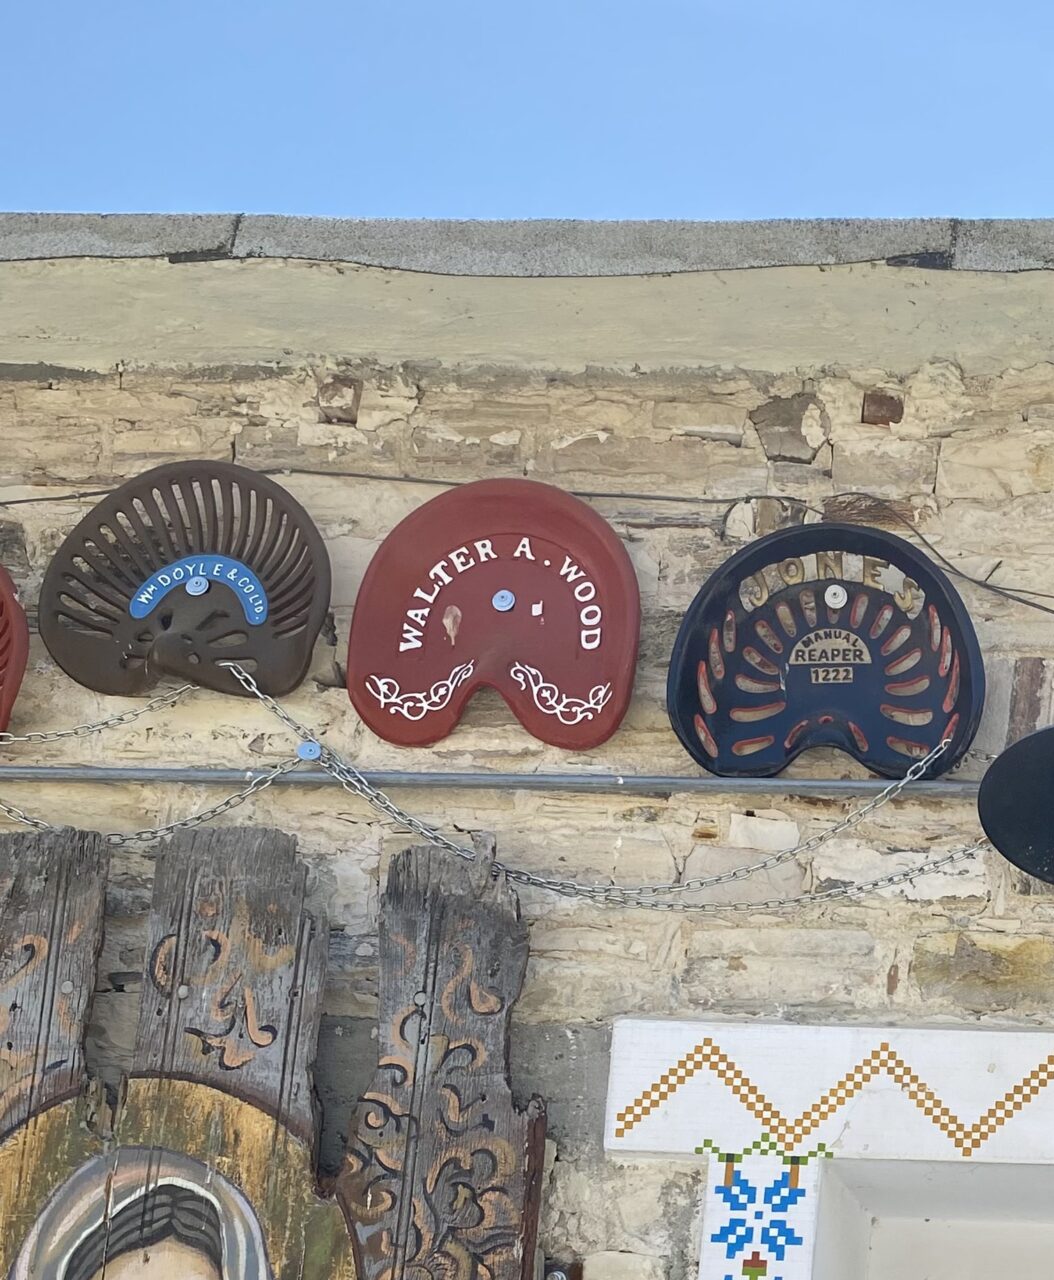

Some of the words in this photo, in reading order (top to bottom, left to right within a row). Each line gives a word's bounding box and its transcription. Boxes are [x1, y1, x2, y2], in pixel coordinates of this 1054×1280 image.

[157, 563, 224, 587] DOYLE
[748, 551, 921, 612] JONES
[399, 539, 498, 652] WALTER
[559, 556, 603, 650] WOOD
[801, 630, 859, 648] MANUAL
[794, 648, 865, 662] REAPER
[812, 668, 852, 682] 1222
